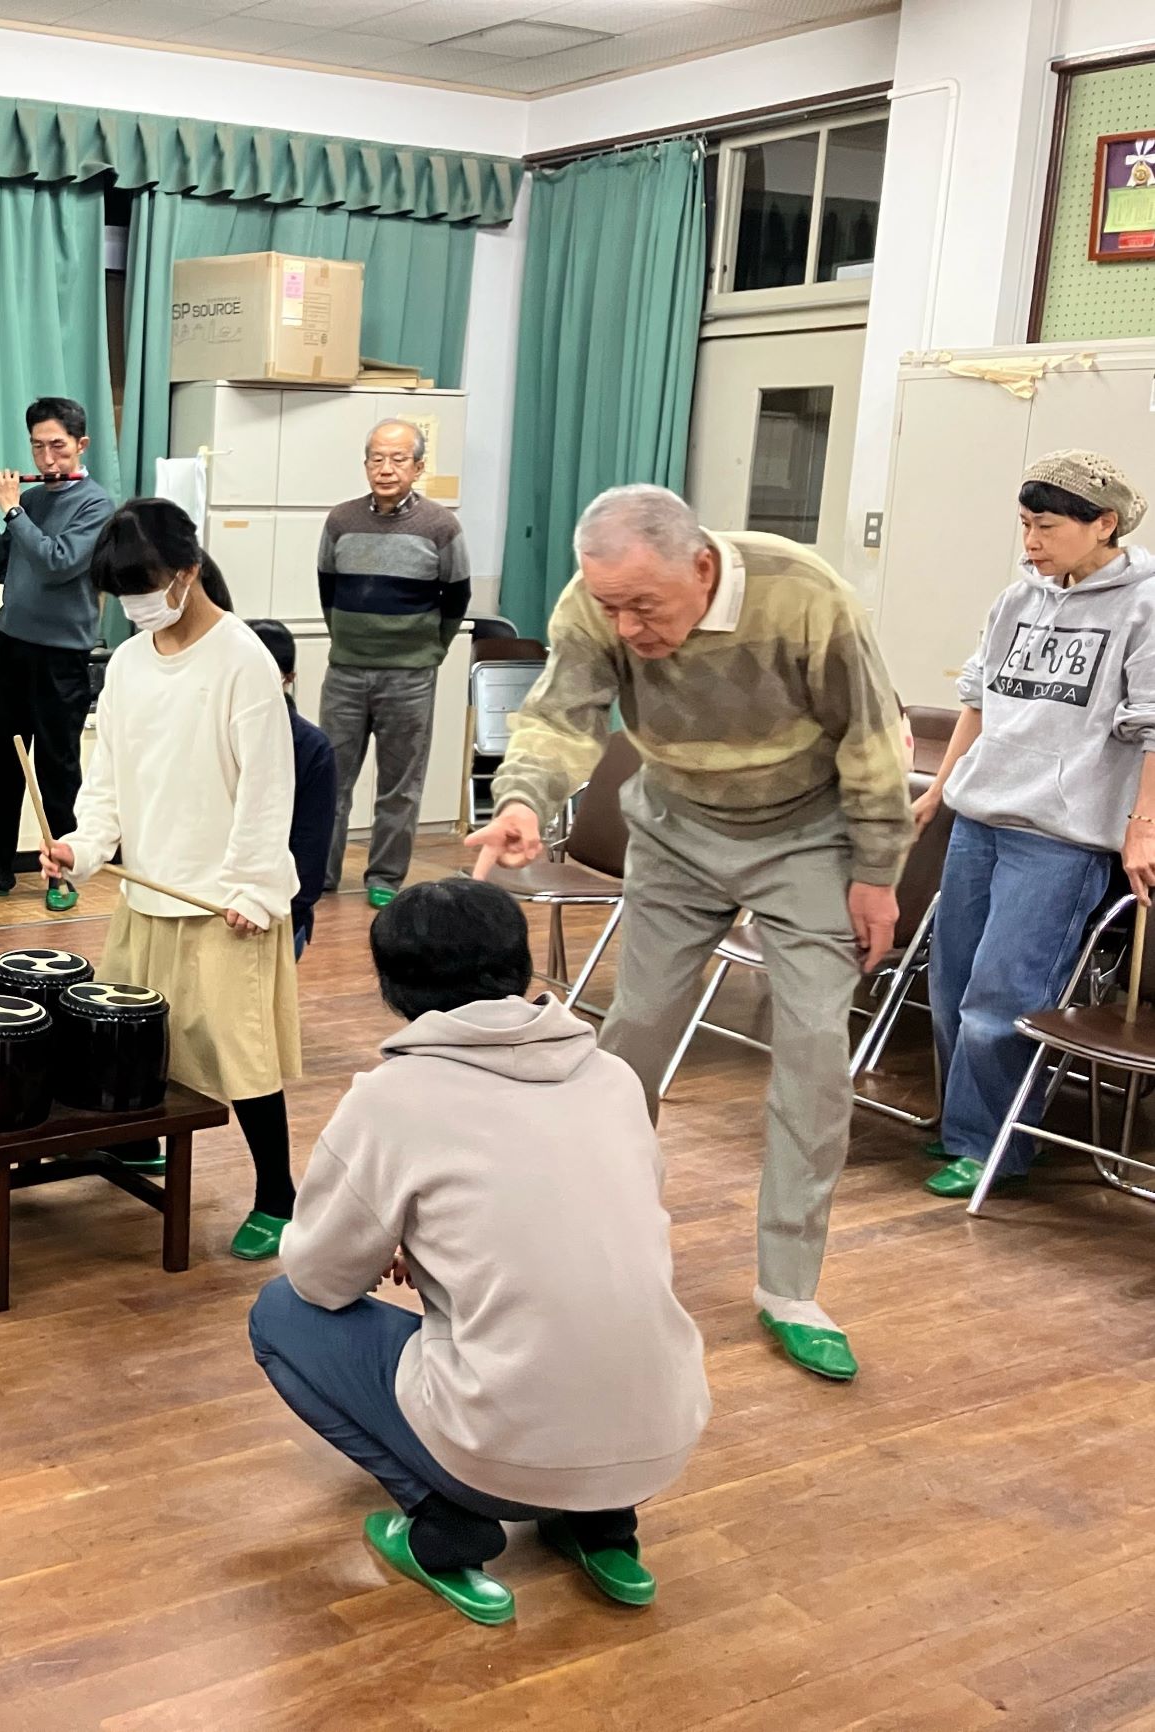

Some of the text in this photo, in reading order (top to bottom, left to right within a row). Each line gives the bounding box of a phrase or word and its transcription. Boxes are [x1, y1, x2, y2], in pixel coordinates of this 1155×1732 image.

[193, 302, 241, 317] SOURCE
[1008, 649, 1086, 675] CLUB
[1000, 679, 1024, 696] SPA
